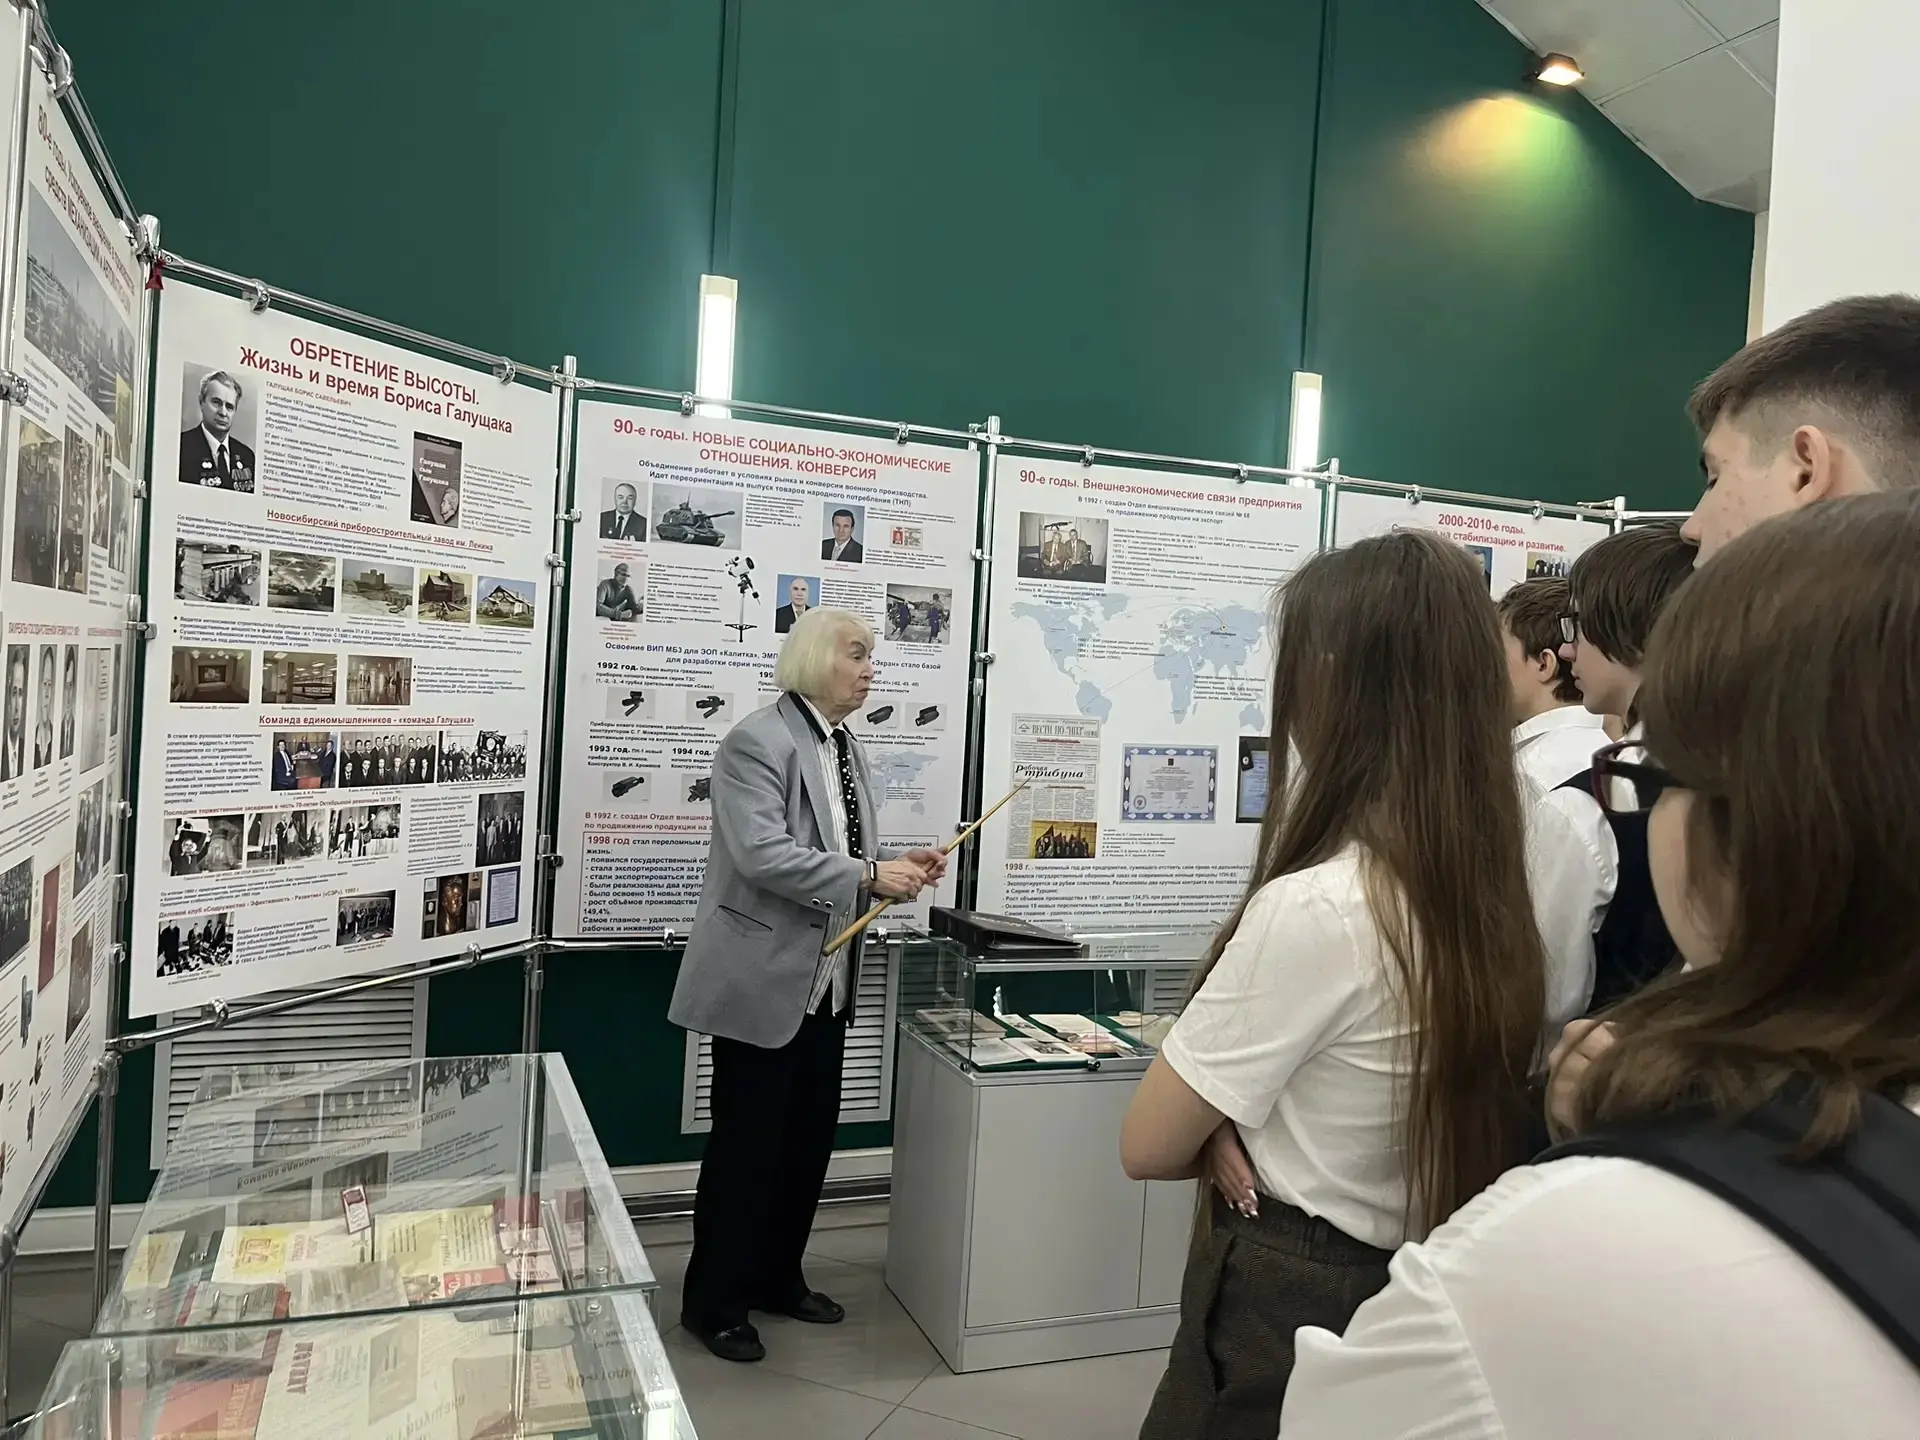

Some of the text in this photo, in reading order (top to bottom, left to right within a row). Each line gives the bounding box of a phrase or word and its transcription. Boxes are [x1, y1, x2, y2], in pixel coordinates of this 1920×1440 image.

[290, 338, 480, 405] ОБРЕТЕНИЕ ВЫСОТЫ.
[240, 346, 512, 434] Жизнь и время Бориса Галущака
[614, 418, 951, 473] 90-е годы. НОВЫЕ СОЦИАЛЬНО-ЭКОНОМИЧЕСКИЕ
[700, 448, 876, 480] ОТНОШЕНИЯ. КОНВЕРСИЯ
[638, 459, 693, 473] Объединение
[694, 467, 729, 478] работает
[737, 472, 773, 482] условиях
[774, 476, 797, 485] рынка
[805, 480, 843, 490] конверсии
[845, 484, 877, 493] военного
[878, 488, 929, 499] производства.
[649, 471, 669, 480] Идет
[670, 474, 734, 488] переориентация
[746, 482, 773, 492] выпуск
[775, 485, 805, 496] товаров
[807, 489, 845, 500] народного
[846, 493, 891, 505] потребления
[892, 498, 912, 508] (ТНП)
[1020, 469, 1302, 510] 90-е годы. Внешнеэкономические связи предприятия
[1084, 496, 1098, 504] 1992
[1127, 501, 1147, 509] Отдел
[267, 509, 494, 551] Новосибирский приборостроительный завод им. Ленина
[1438, 513, 1525, 535] 2000-2010-е годы.
[1453, 532, 1516, 548] стабилизацию
[1526, 540, 1566, 552] развитие.
[605, 642, 645, 652] Освоение
[596, 661, 638, 671] 1992 год.
[666, 656, 681, 664] для
[683, 658, 726, 667] разработки
[728, 660, 751, 668] серии
[872, 660, 899, 668] «Экран»
[921, 662, 941, 670] базой
[259, 715, 475, 726] Команда единомышленников «команда Галущака»
[612, 746, 631, 754] год.
[1024, 769, 1084, 779] трибуна
[587, 836, 611, 845] 1998
[613, 838, 630, 846] год
[1005, 863, 1023, 871] 1998
[614, 874, 685, 882] экспортироваться
